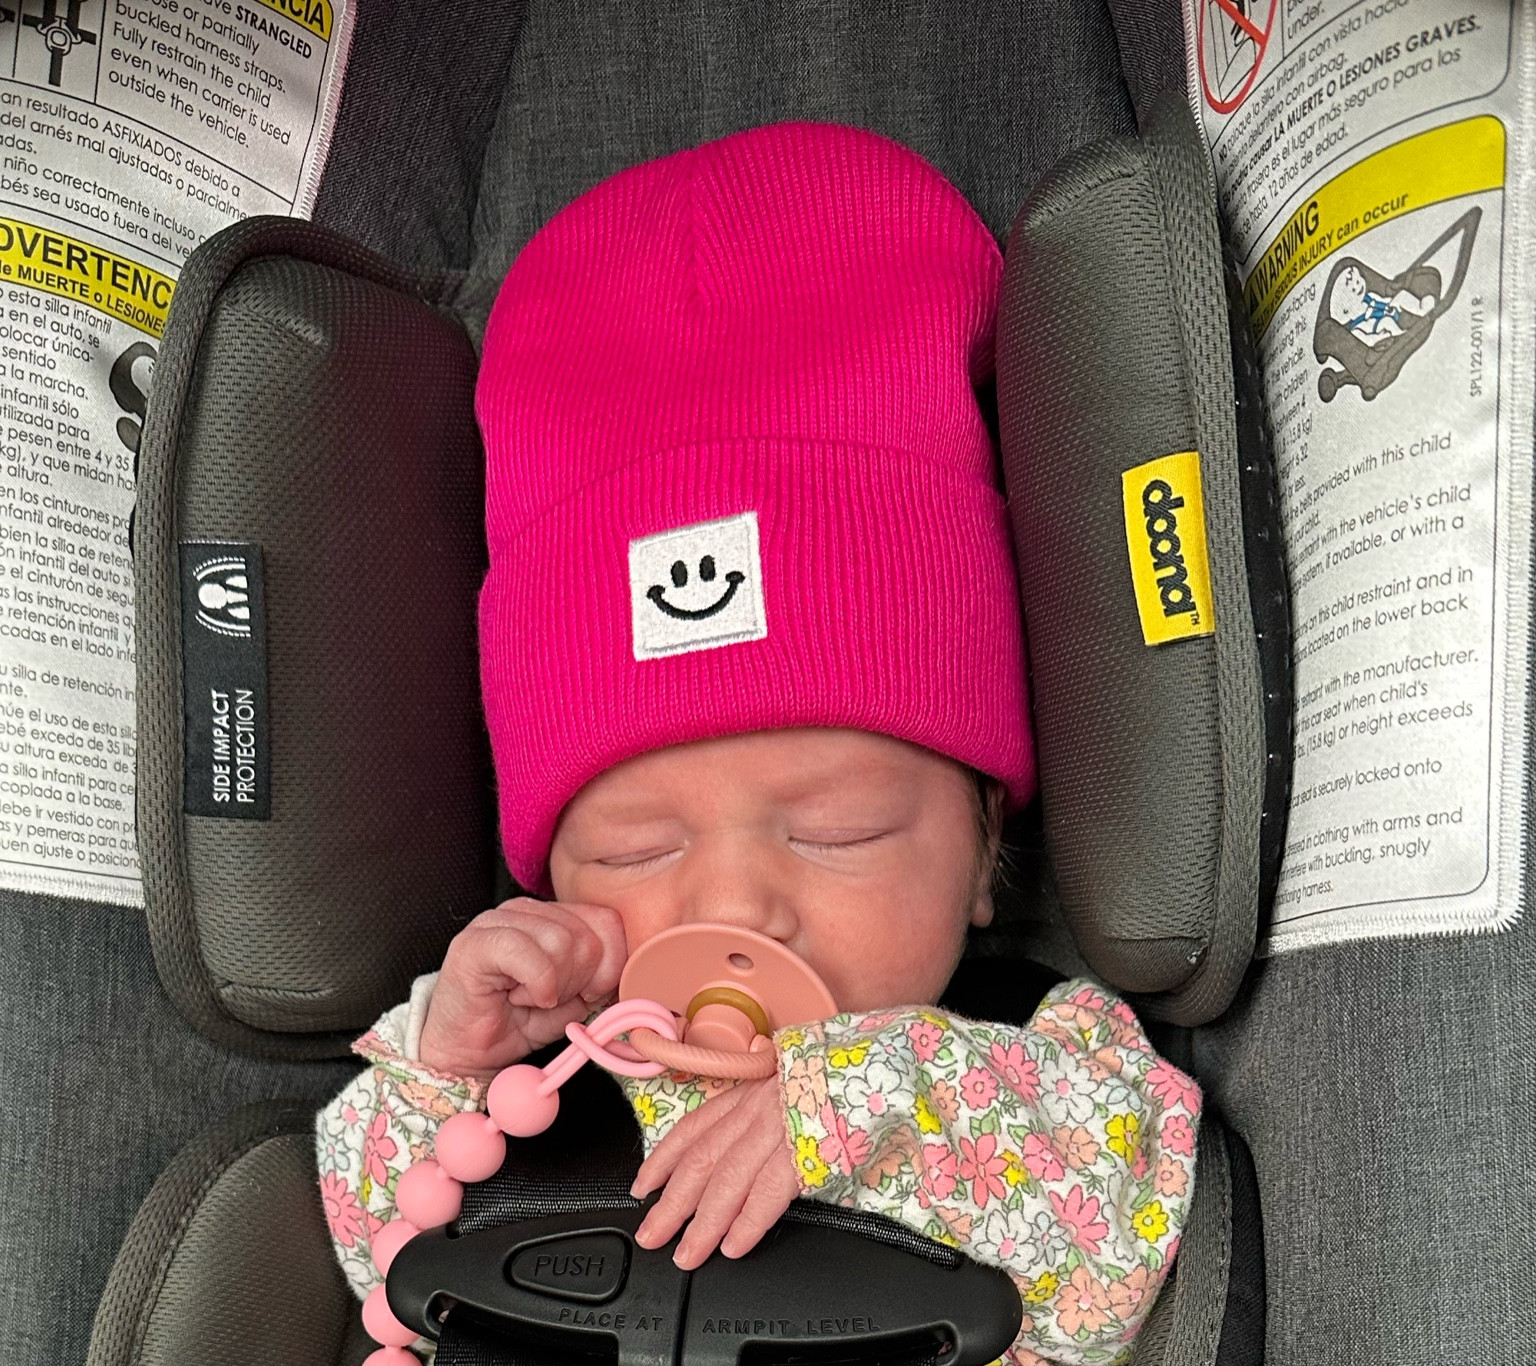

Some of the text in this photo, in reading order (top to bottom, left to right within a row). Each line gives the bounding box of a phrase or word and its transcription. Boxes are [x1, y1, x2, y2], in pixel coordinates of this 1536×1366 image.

[183, 7, 260, 56] or partially
[235, 6, 312, 59] STRANGLED
[1286, 1, 1325, 39] under.
[116, 0, 287, 93] buckled harness straps.
[1307, 19, 1362, 63] con vista
[113, 22, 272, 108] Fully restrain the child
[1286, 15, 1481, 134] MUERTE LESIONES GRAVES.
[1306, 51, 1348, 93] airbag.
[1344, 48, 1462, 112] seguro para los
[108, 69, 250, 149] outside the vehicle.
[111, 47, 292, 145] even when carrier is used
[1, 111, 173, 185] del arnés mal ajustadas
[26, 96, 229, 192] resultado ASFIXIADOS debido
[1316, 124, 1349, 160] edad.
[4, 154, 196, 243] niño correctamente incluso
[33, 185, 110, 223] sea usado
[113, 212, 173, 251] fuera del
[1256, 200, 1320, 292] WARNING
[1298, 194, 1409, 268] INJURY can occur
[18, 263, 90, 298] MUERTE
[8, 289, 112, 334] esta silla infantil
[9, 311, 101, 349] en el auto, se
[1, 345, 57, 370] sentido
[52, 333, 94, 363] única-
[11, 362, 89, 400] la marcha.
[0, 384, 79, 420] infantil sólo
[8, 426, 52, 450] pesen
[57, 421, 90, 442] para
[42, 455, 114, 486] que midan
[56, 441, 129, 471] entre 35
[1352, 431, 1452, 478] with this child
[7, 464, 53, 487] altura.
[20, 487, 110, 525] los cinturones
[1359, 483, 1471, 526] vehicle's child
[35, 532, 96, 560] la silla de
[47, 515, 110, 543] alrededor
[1332, 514, 1464, 567] available, or with a
[10, 562, 103, 599] el cinturón de
[19, 546, 120, 587] infantil del auto
[1356, 565, 1473, 605] restraint and in
[8, 606, 119, 641] retención infantil
[14, 586, 120, 624] las instrucciones
[1352, 593, 1469, 635] the lower back
[50, 632, 114, 658] en lado
[12, 665, 122, 700] silla de retención
[1343, 649, 1479, 686] the manufacturer.
[1343, 680, 1428, 714] when child's
[29, 709, 117, 737] el uso de esta
[1350, 701, 1474, 736] height exceeds
[14, 742, 129, 774] altura exceda de
[30, 727, 120, 755] exceda de 35
[211, 689, 230, 803] SIDE IMPACT
[235, 689, 255, 803] PROTECTION
[13, 763, 117, 795] silla infantil para
[1355, 758, 1442, 786] locked onto
[79, 790, 126, 812] la base.
[27, 824, 117, 851] perneras para
[46, 809, 120, 831] vestido con
[1352, 806, 1463, 835] with arms and
[34, 843, 74, 860] ajuste
[1325, 844, 1375, 868] buckling,
[1379, 836, 1431, 858] snugly
[534, 1254, 605, 1278] PUSH
[559, 1308, 881, 1336] PLACE AT ARMPIT LEVEL
